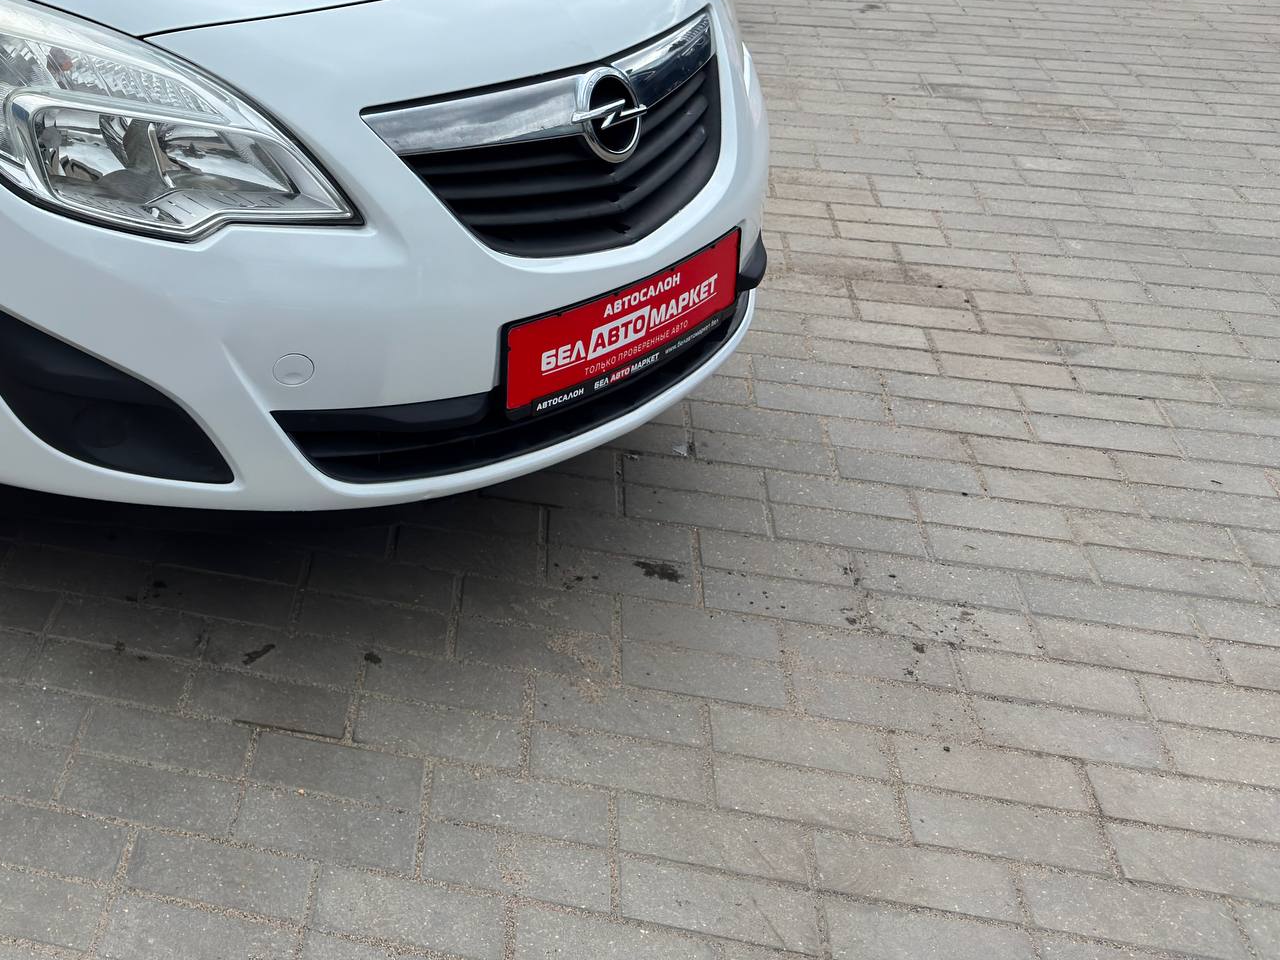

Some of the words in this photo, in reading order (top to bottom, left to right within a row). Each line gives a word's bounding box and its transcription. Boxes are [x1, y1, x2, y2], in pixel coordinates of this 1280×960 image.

[603, 272, 681, 318] АВТОСАЛОН
[584, 355, 617, 375] ТОЛЬКО
[617, 329, 670, 361] ПРОВЕРЕННЫЕ
[670, 319, 689, 336] АВТО
[536, 387, 584, 411] АВТОСАЛОН
